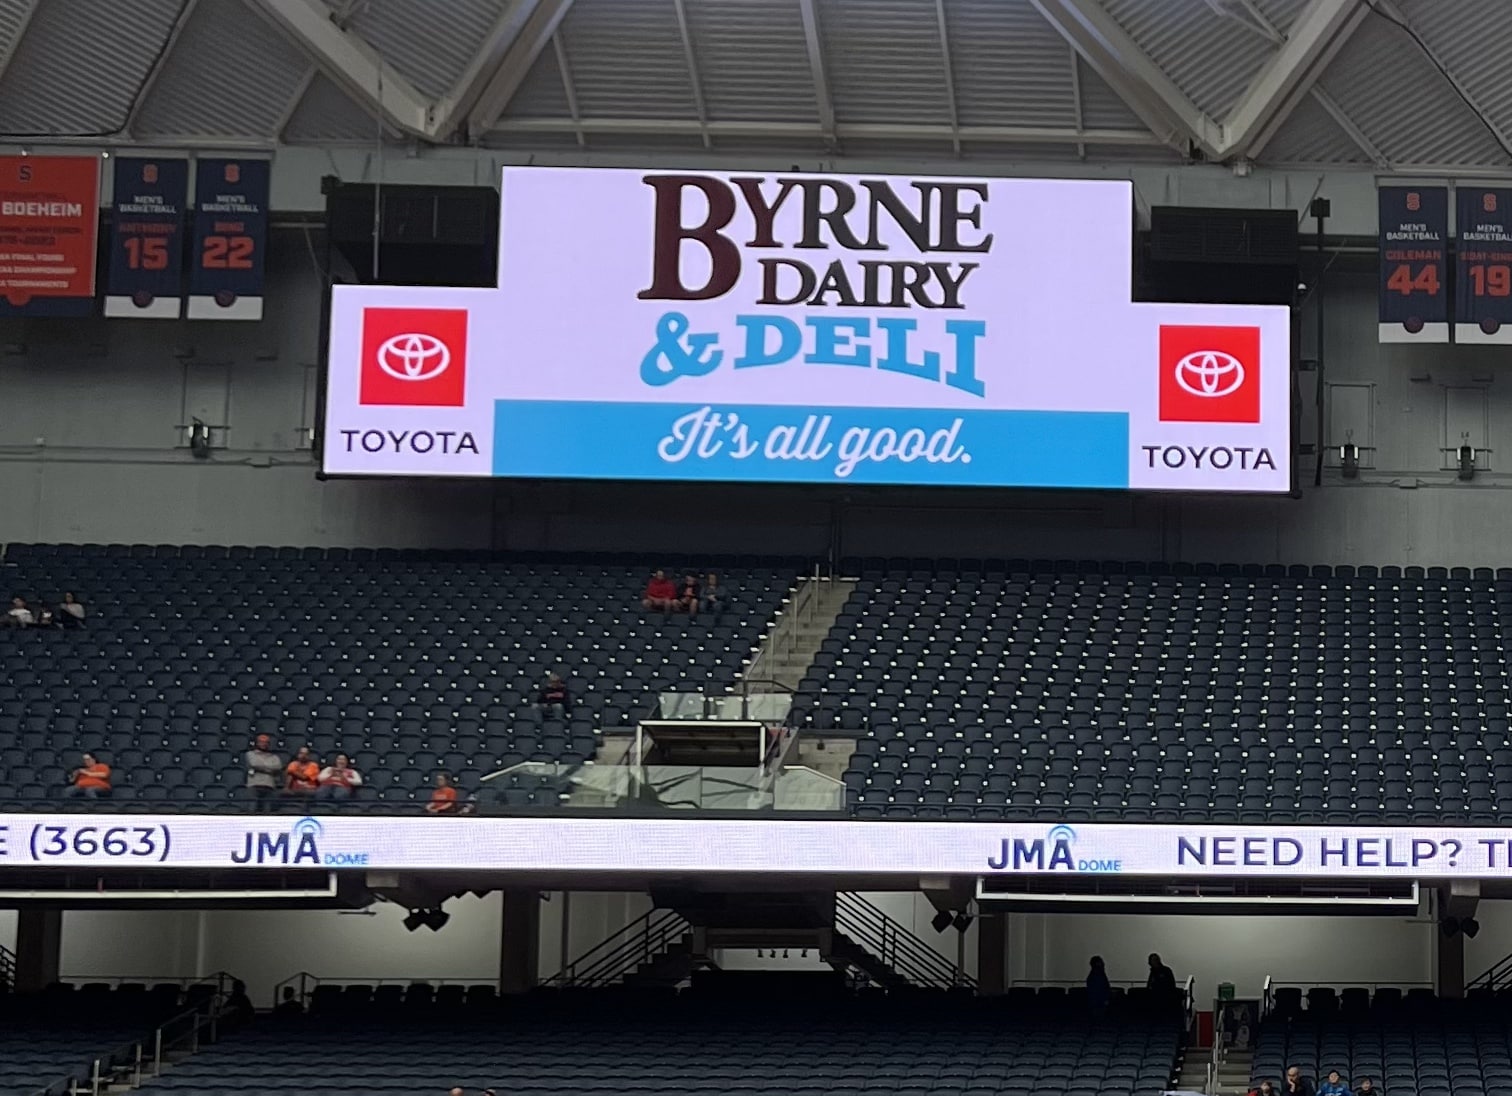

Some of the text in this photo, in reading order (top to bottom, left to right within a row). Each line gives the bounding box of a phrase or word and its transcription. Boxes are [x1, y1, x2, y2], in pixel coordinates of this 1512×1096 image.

[638, 173, 993, 300] BYRNE
[1386, 231, 1440, 241] BASKETBALL
[1400, 223, 1427, 232] MEN'S
[1476, 224, 1503, 233] MEN'S
[123, 237, 168, 269] 15
[202, 236, 255, 269] 22
[755, 257, 982, 309] DAIRY
[1387, 265, 1440, 295] 44
[1469, 265, 1511, 297] 19
[640, 311, 985, 398] & DELI
[340, 430, 480, 455] TOYOTA
[656, 406, 973, 478] It's all good.
[1142, 445, 1277, 471] TOYOTA
[29, 826, 172, 864] (3663)
[231, 831, 369, 865] JMA DOME
[987, 838, 1121, 871] JMA DOME
[1177, 836, 1303, 868] NEED
[1321, 837, 1461, 868] HELP?
